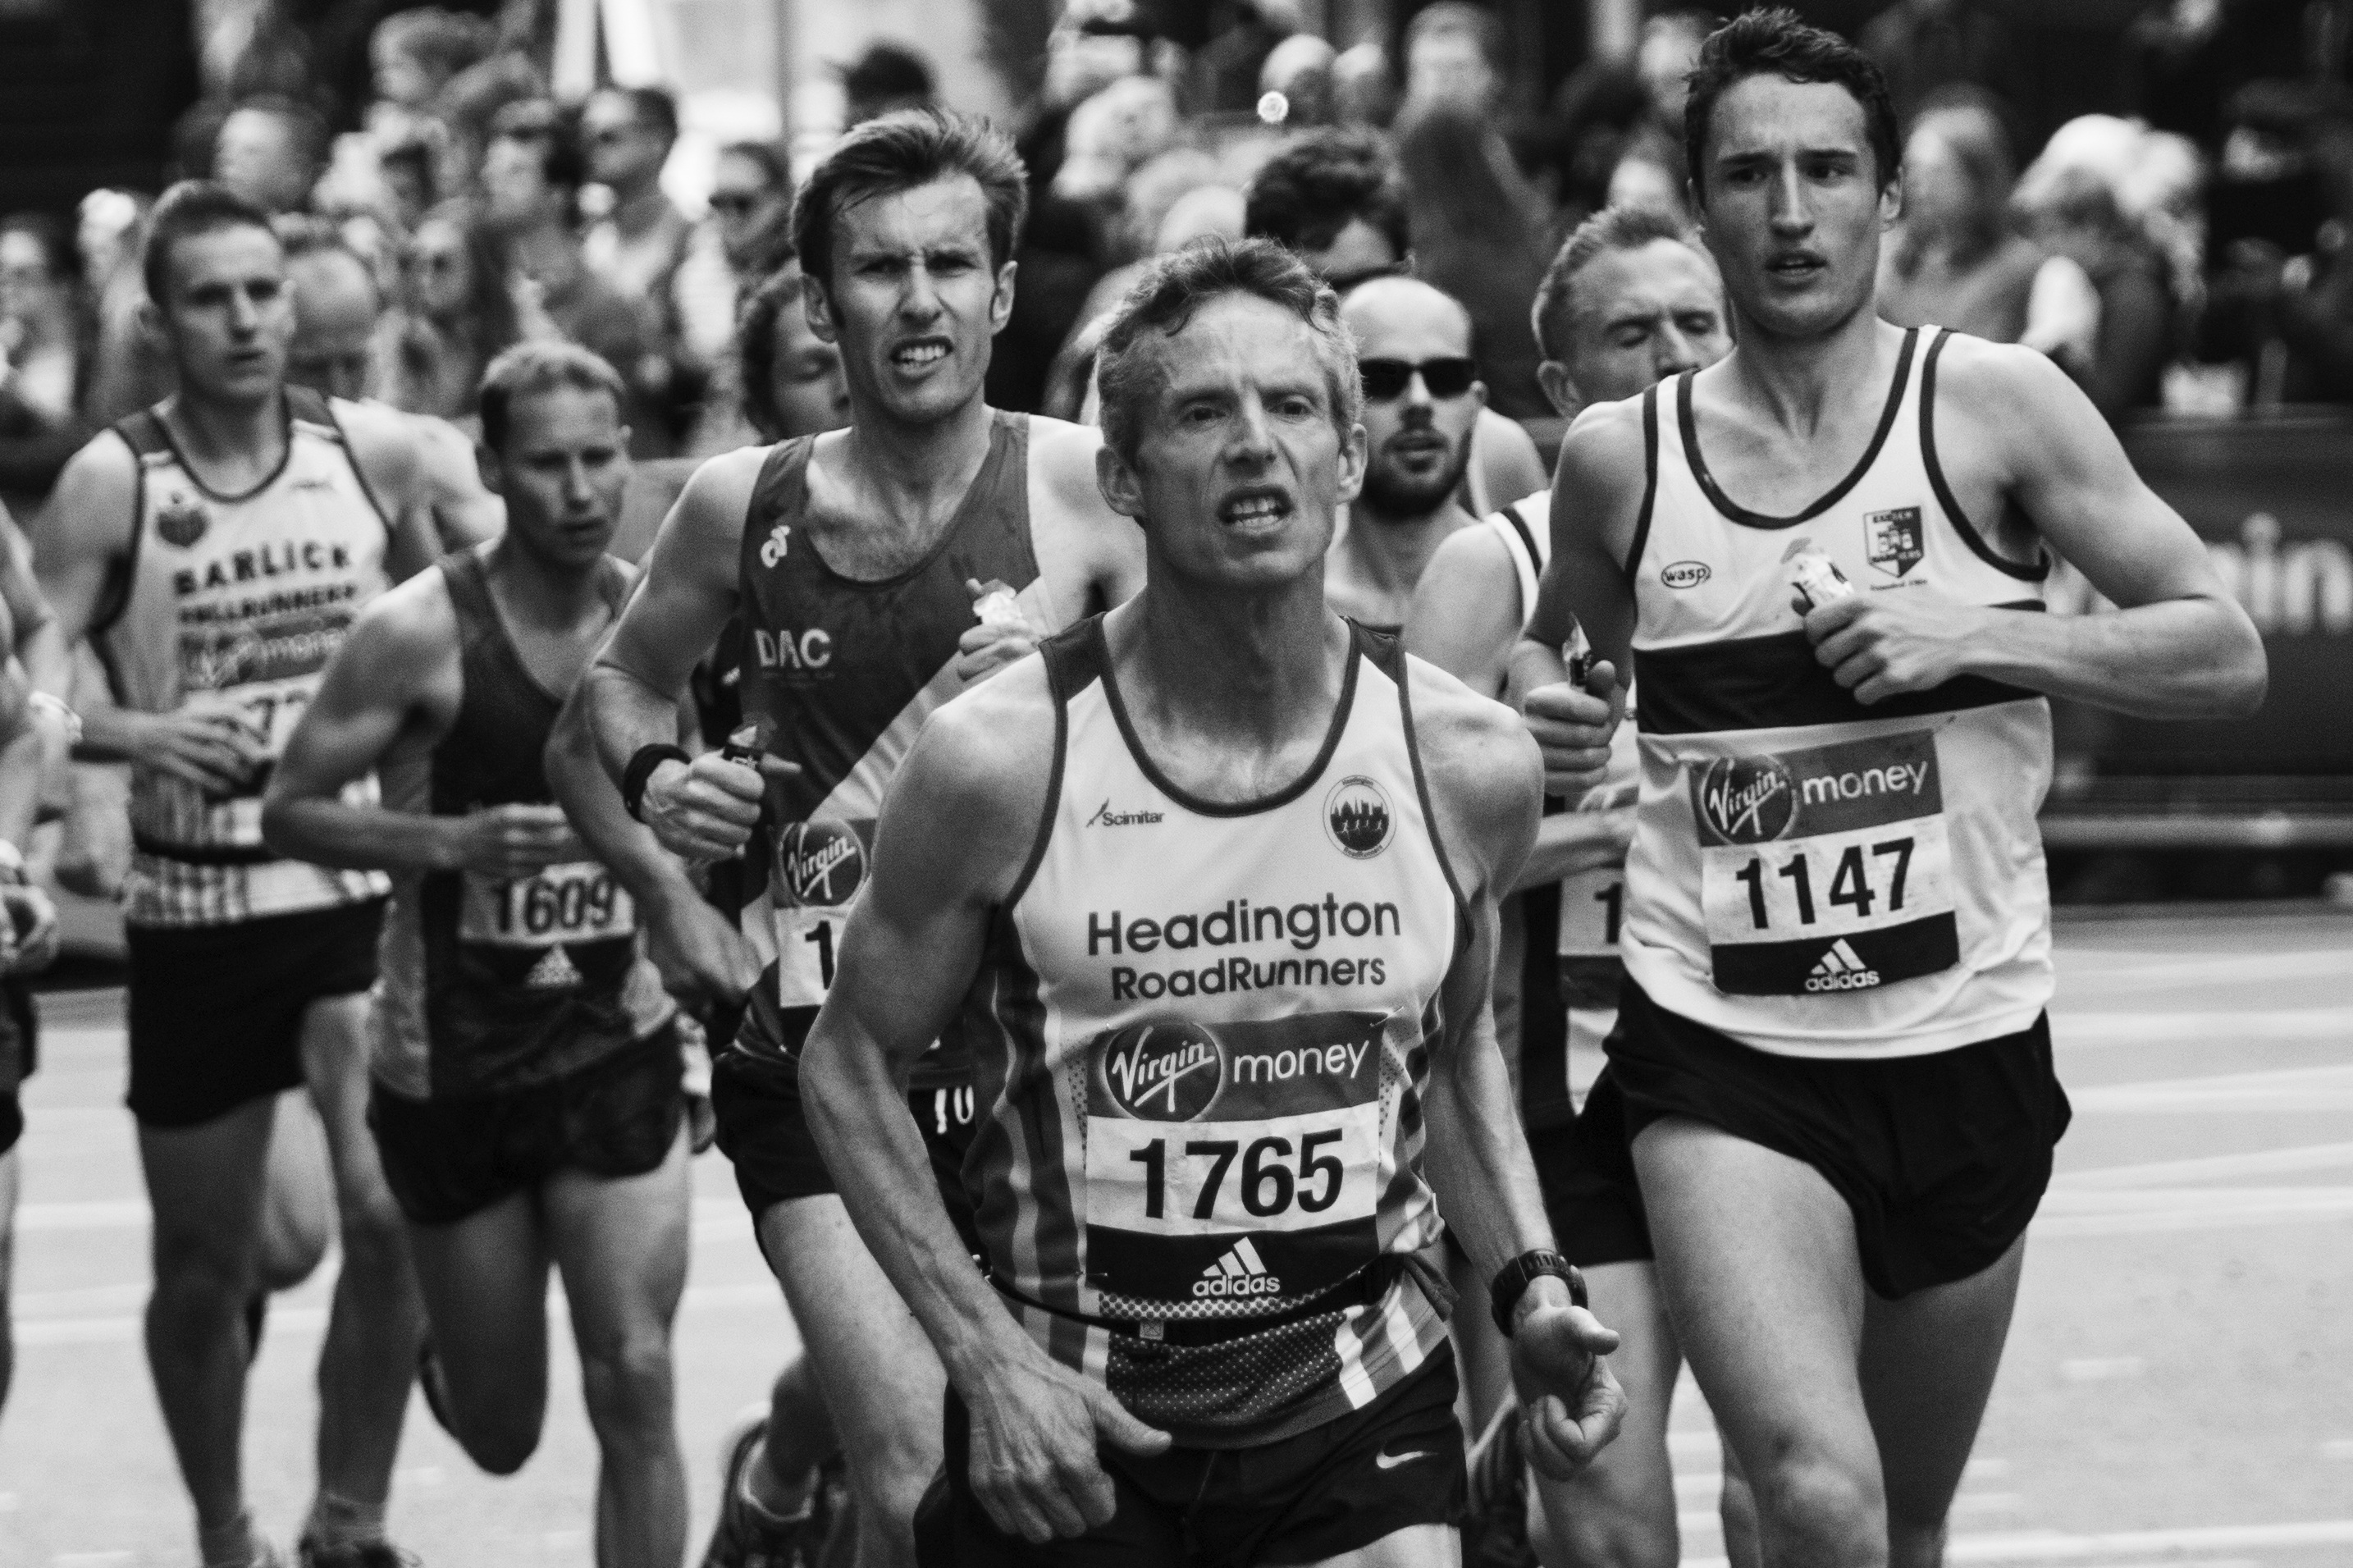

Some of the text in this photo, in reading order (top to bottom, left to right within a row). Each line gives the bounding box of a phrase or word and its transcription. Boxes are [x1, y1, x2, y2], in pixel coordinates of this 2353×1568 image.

[1664, 568, 1706, 583] wasp
[755, 627, 831, 669] DAC
[1102, 809, 1165, 827] Scimitar
[1710, 759, 1928, 836] Virgin money
[788, 823, 857, 900] Virgin
[1735, 837, 1914, 930] 1147
[494, 876, 615, 935] 1609
[1088, 892, 1400, 956] Headington
[1111, 957, 1387, 1001] RoadRunners
[1805, 971, 1880, 992] adidas
[1112, 1026, 1370, 1113] Virgin money
[1129, 1127, 1344, 1220] 1765
[1192, 1275, 1281, 1296] adidas
